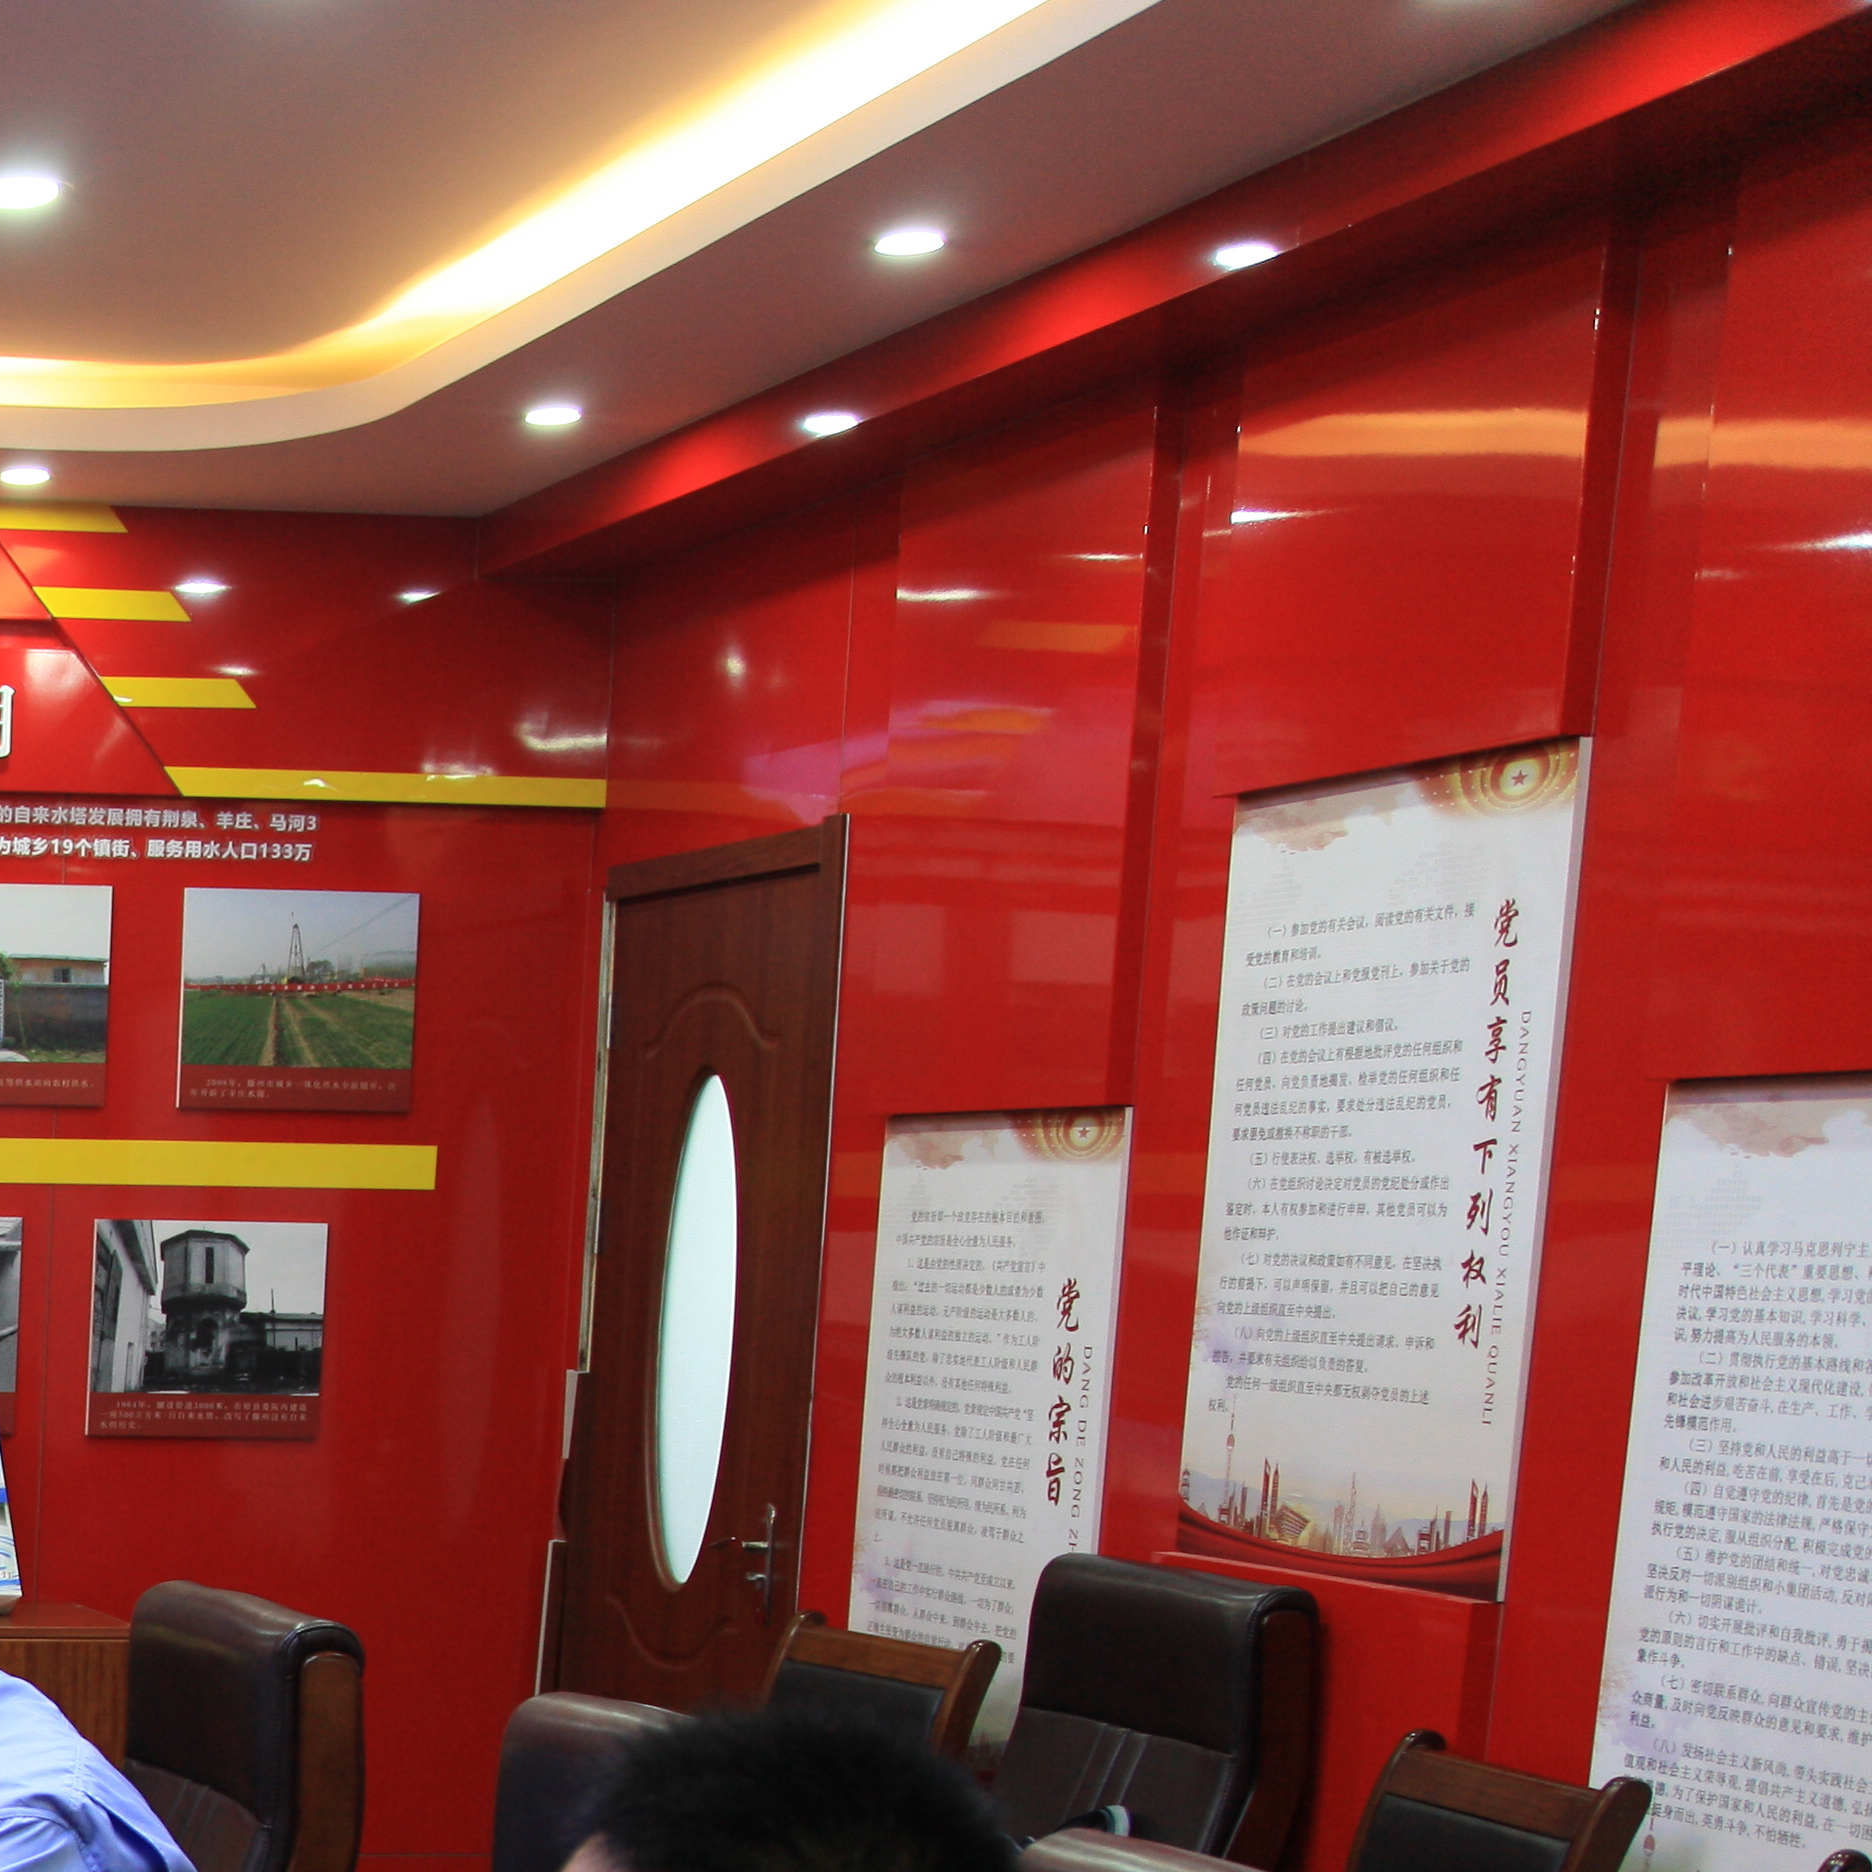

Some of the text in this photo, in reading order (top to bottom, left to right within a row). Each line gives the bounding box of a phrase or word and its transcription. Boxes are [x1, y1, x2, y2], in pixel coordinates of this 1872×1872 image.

[1454, 898, 1519, 1349] 党员享有下列权利
[1481, 1010, 1532, 1426] DANGYUAN XIANGYOU XIALIE QUANLI
[1046, 1278, 1080, 1506] 党的宗旨
[1080, 1346, 1092, 1409] DANG
[1077, 1420, 1087, 1447] DE
[1071, 1458, 1084, 1518] ZONG
[1654, 1500, 1872, 1536] 规矩，模范遵守国家的法律法规，严格保守
[1652, 1737, 1872, 1796] （八）发扬社会主义新风尚，带头实践社会
